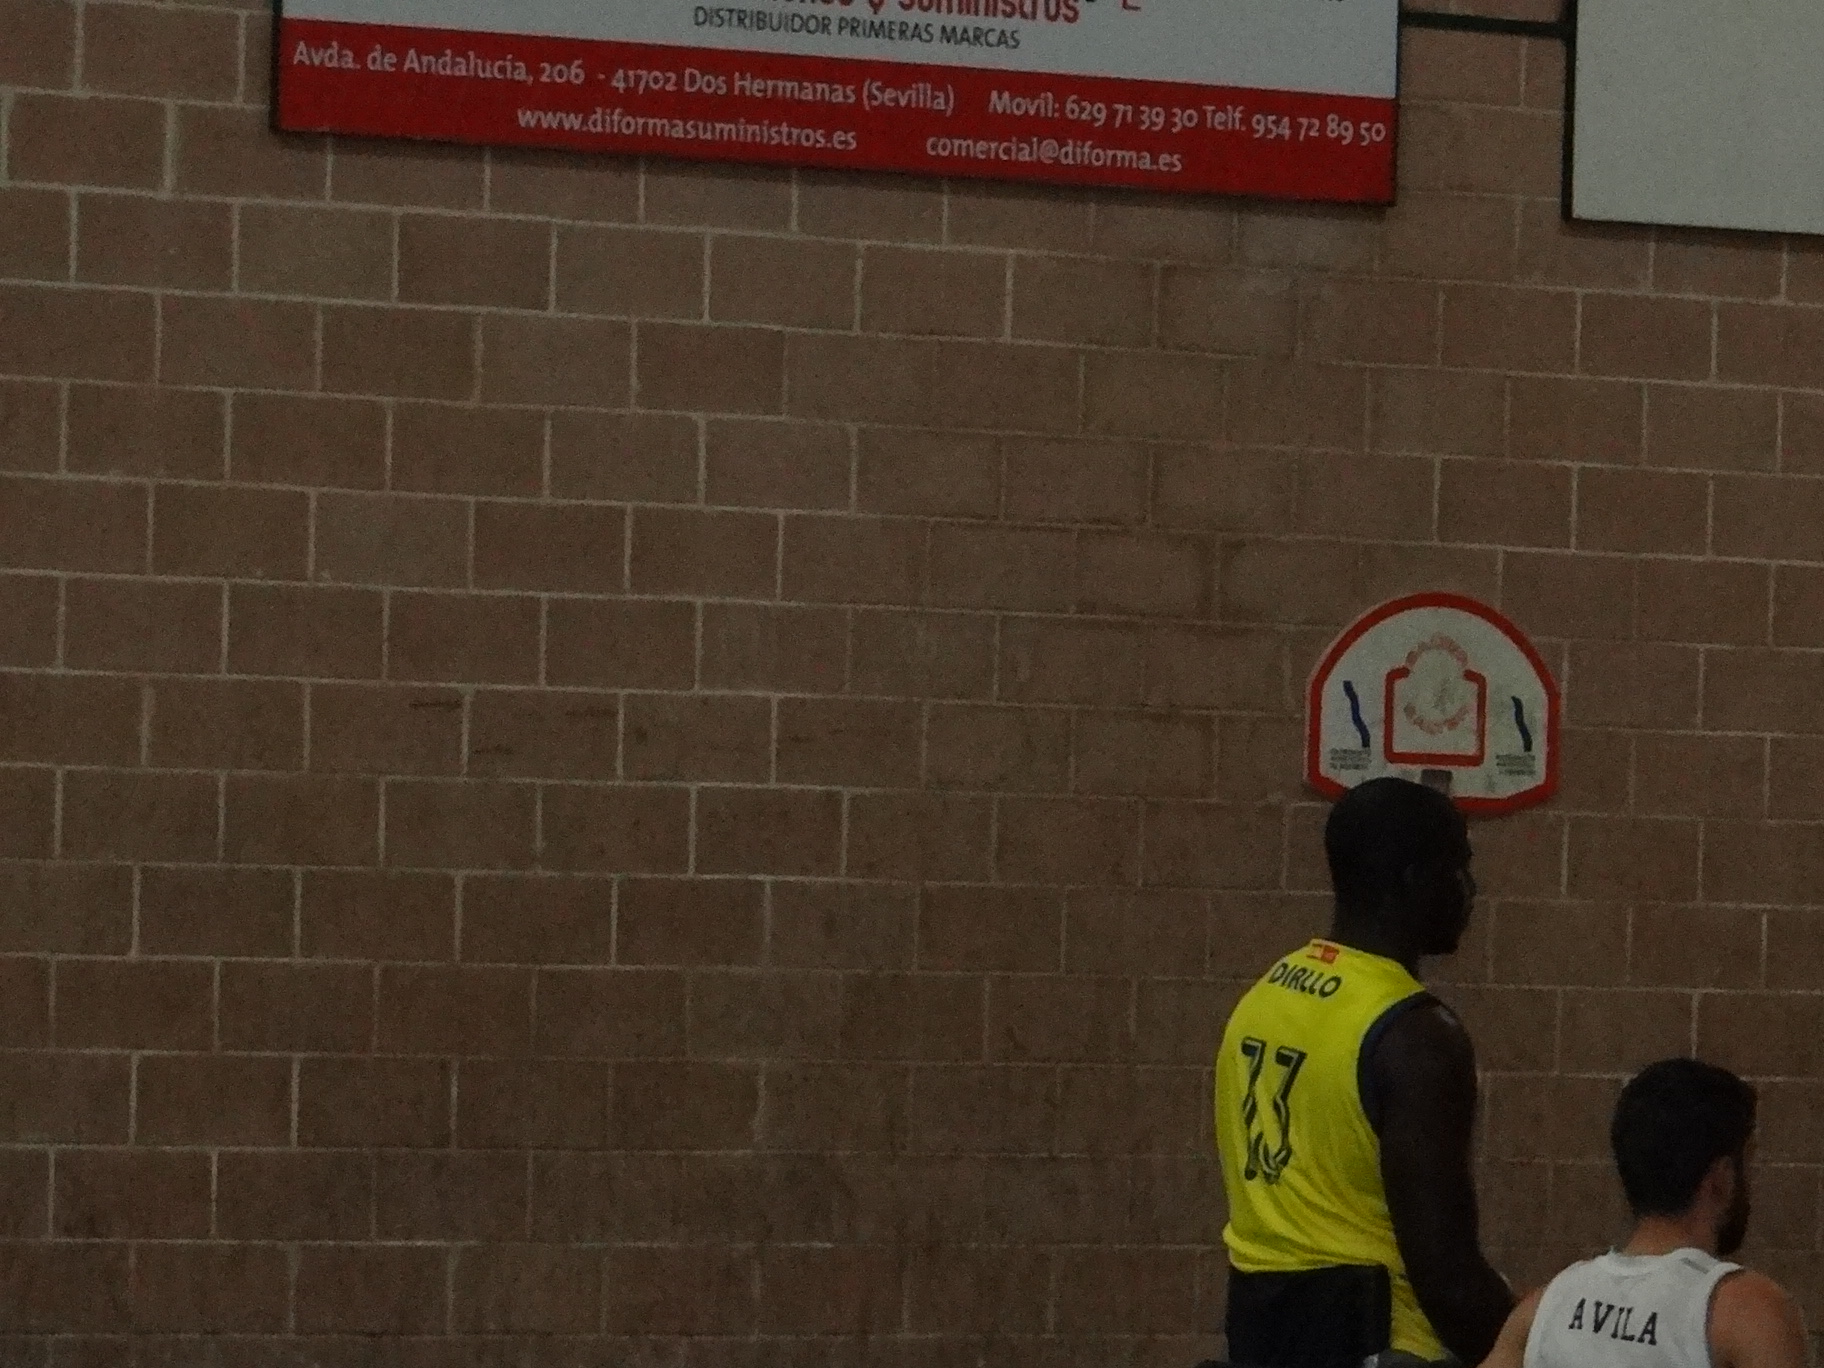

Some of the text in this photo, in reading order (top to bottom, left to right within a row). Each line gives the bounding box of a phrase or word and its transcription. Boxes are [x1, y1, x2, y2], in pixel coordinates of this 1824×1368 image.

[694, 6, 831, 36] DISTRIBUIDOR
[838, 16, 934, 43] PRIMERAS
[939, 25, 1021, 49] MARCAS
[293, 40, 361, 70] Avda.
[367, 44, 398, 72] de
[403, 48, 534, 85] Andalucía,
[540, 59, 586, 84] 206
[611, 68, 677, 95] 41702
[683, 67, 728, 96] Dos
[733, 72, 856, 104] Hermanas
[862, 78, 955, 117] (Sevilla)
[1065, 94, 1107, 127] 629
[1112, 103, 1132, 128] 71
[1139, 105, 1166, 131] 39
[1171, 107, 1198, 133] 30
[1203, 104, 1246, 131] Telf.
[1251, 114, 1292, 140] 954
[1297, 117, 1320, 141] 72
[1326, 113, 1354, 145] 89
[1359, 122, 1386, 146] 50
[517, 106, 857, 150] www.diformasuministros.es
[926, 136, 1182, 173] comercial@diforma.es
[1568, 1298, 1657, 1345] AVILA
